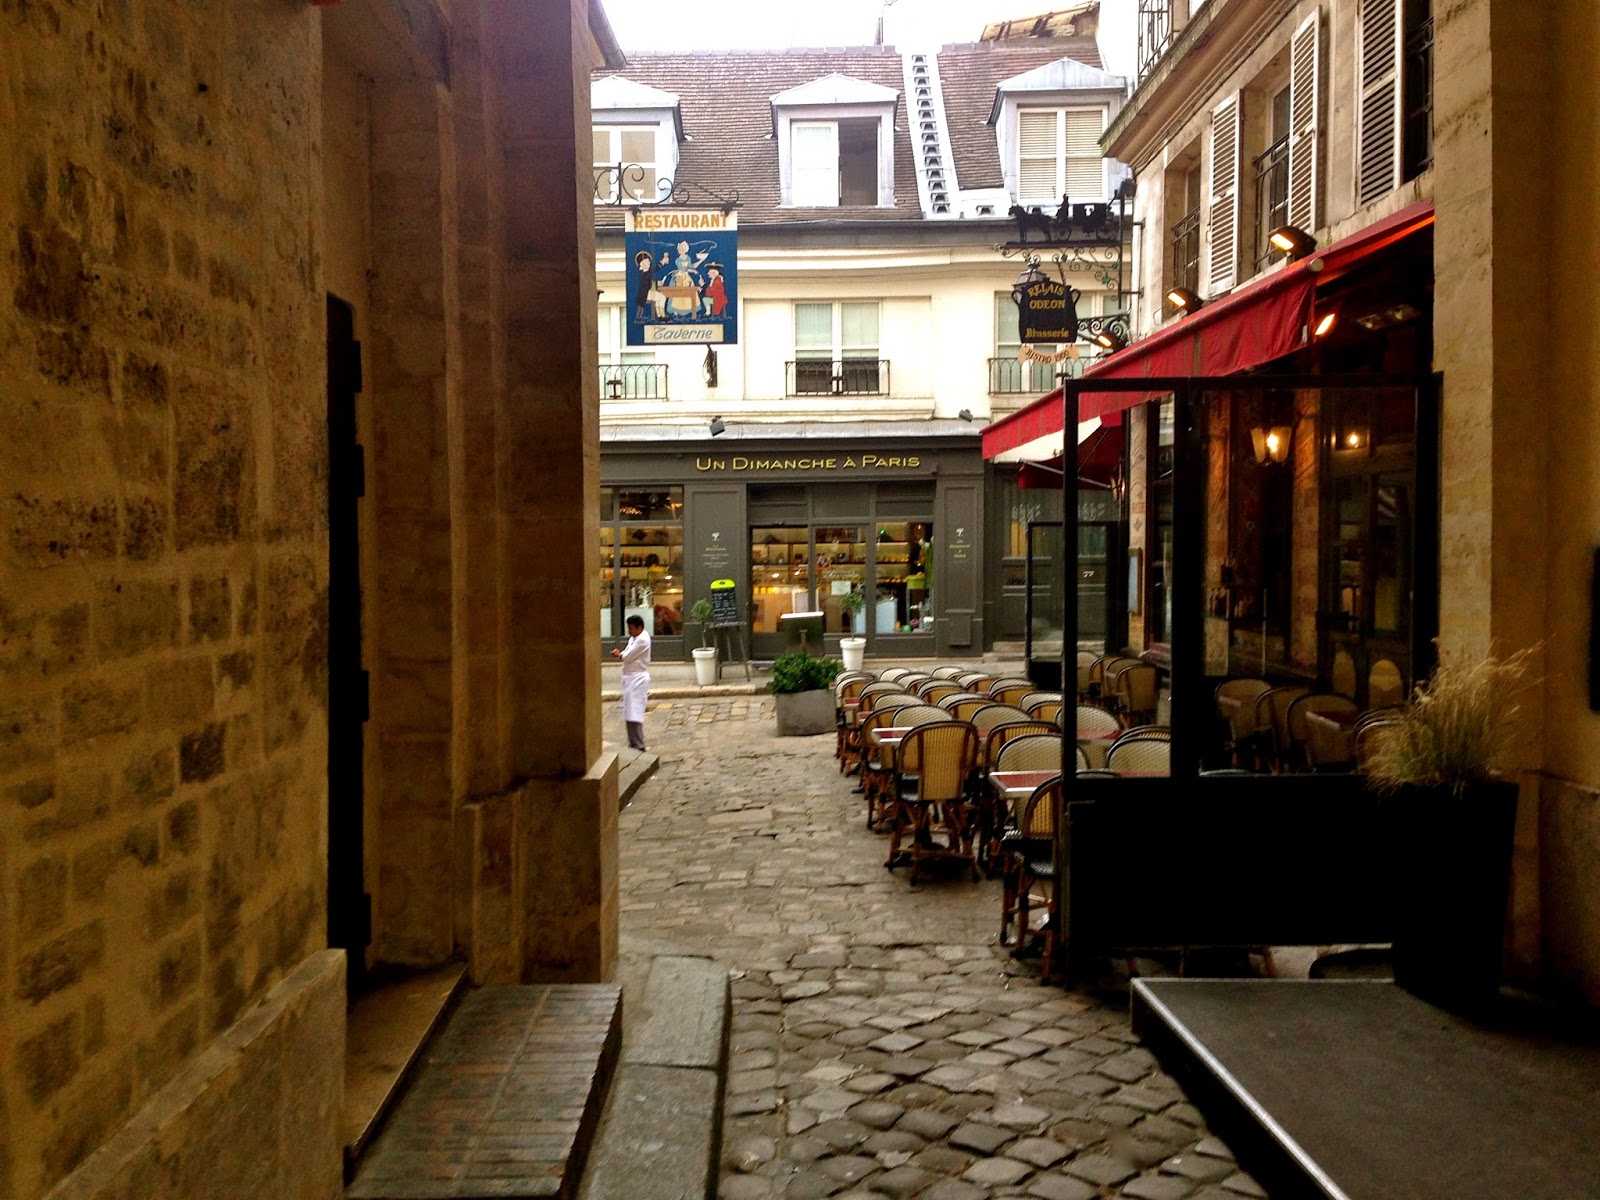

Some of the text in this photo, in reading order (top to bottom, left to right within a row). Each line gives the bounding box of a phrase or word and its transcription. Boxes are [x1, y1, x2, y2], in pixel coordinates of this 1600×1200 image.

[635, 213, 728, 229] RESTAURANT
[1027, 283, 1065, 297] RELAIS
[1029, 299, 1066, 309] ODEON
[653, 326, 713, 340] Taverne
[1025, 327, 1070, 338] Brasserie
[1025, 349, 1052, 364] BISTRO
[695, 457, 725, 471] UN
[732, 457, 837, 471] DIMANCHE
[862, 454, 921, 468] PARIS
